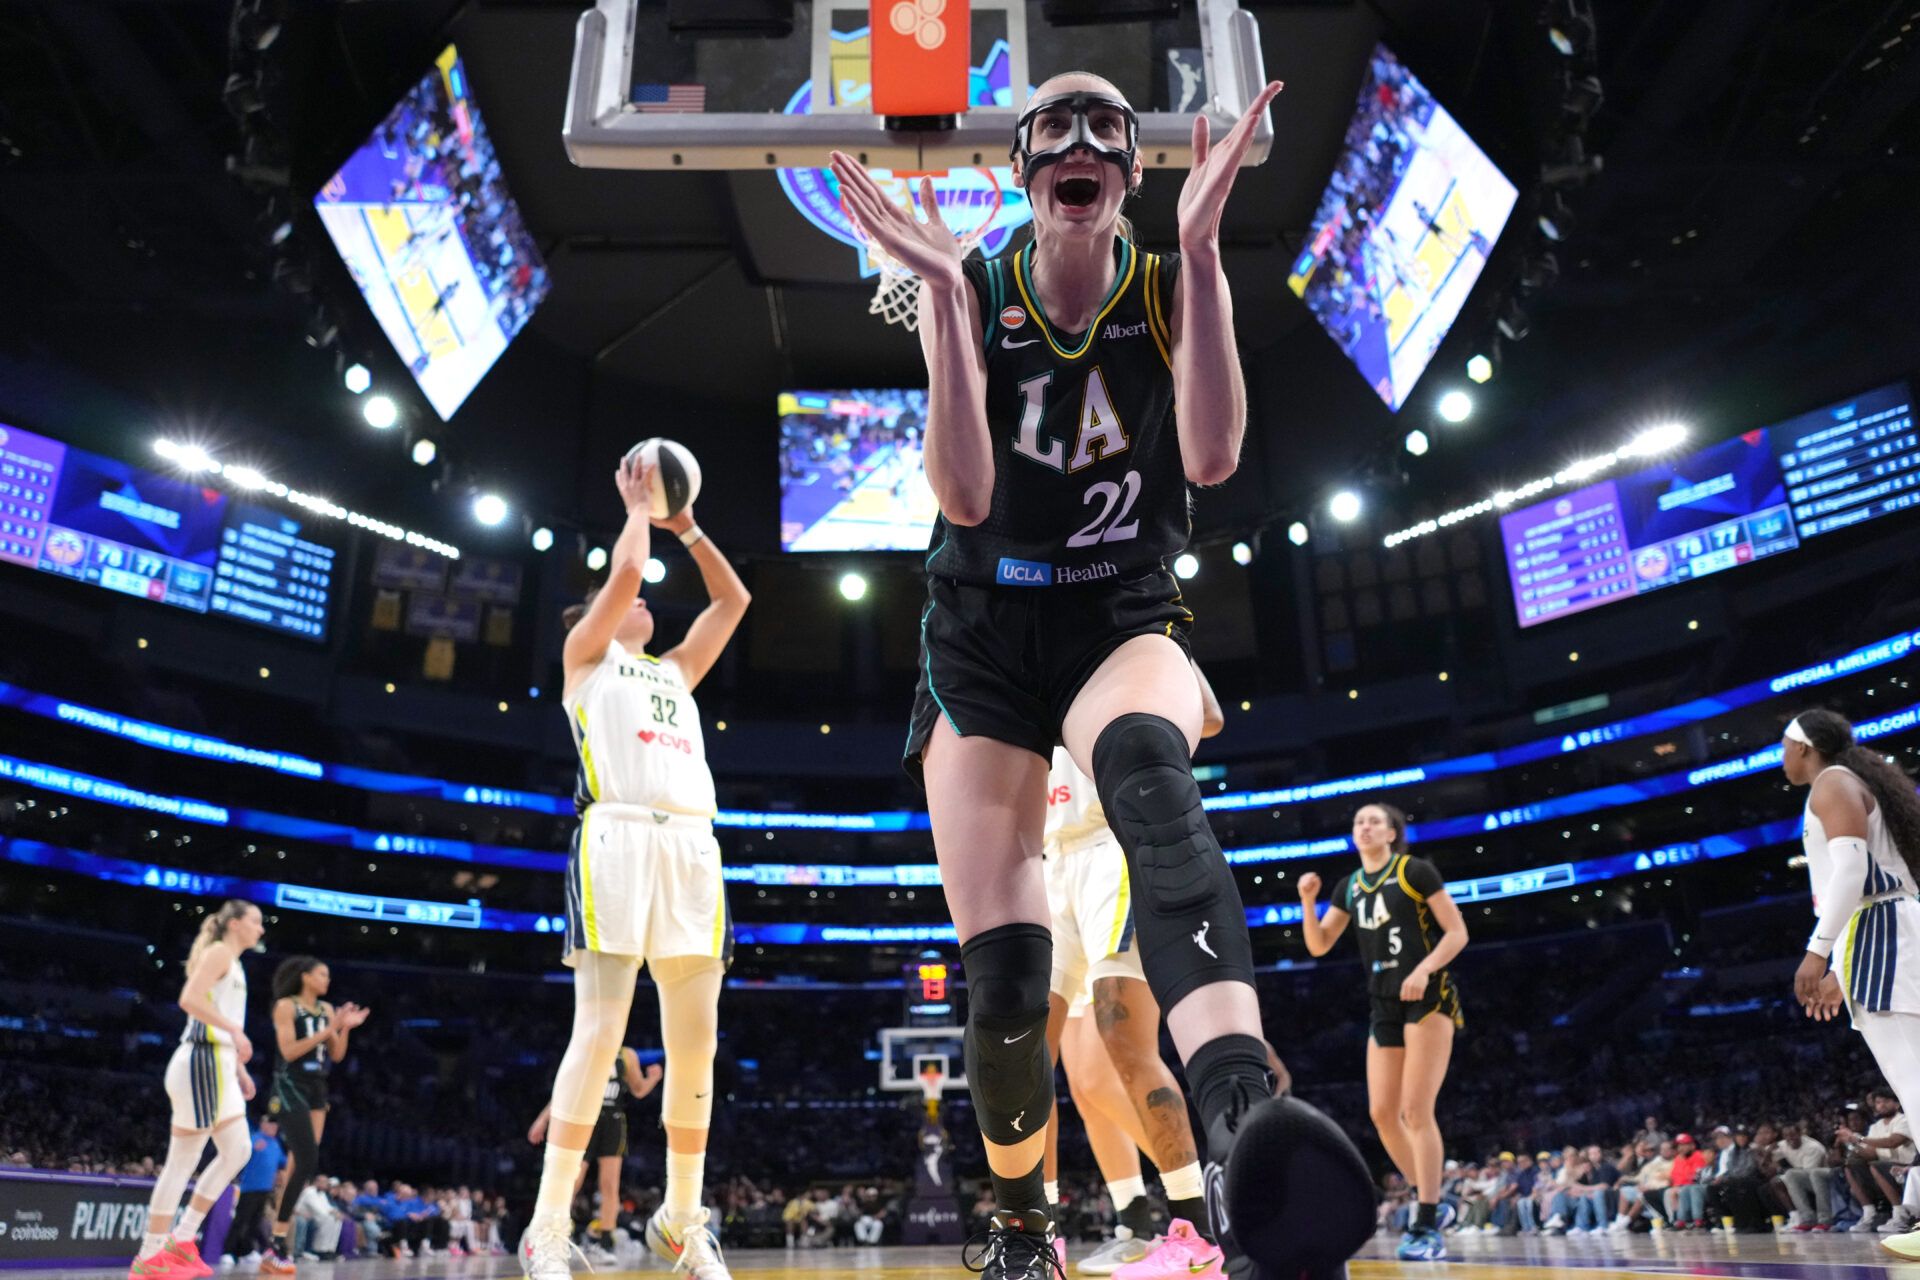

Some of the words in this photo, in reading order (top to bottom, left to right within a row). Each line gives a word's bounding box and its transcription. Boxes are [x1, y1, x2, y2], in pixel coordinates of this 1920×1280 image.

[1102, 321, 1148, 339] Albert
[1012, 365, 1130, 474] LA
[1066, 470, 1142, 548] 22
[1003, 564, 1044, 582] UCLA
[1056, 561, 1118, 584] Health
[651, 694, 678, 727] 32
[658, 732, 692, 754] CVS
[1356, 892, 1391, 931] LA
[1388, 926, 1402, 955] 5
[71, 1202, 121, 1240] PLAY
[119, 1204, 151, 1240] FO
